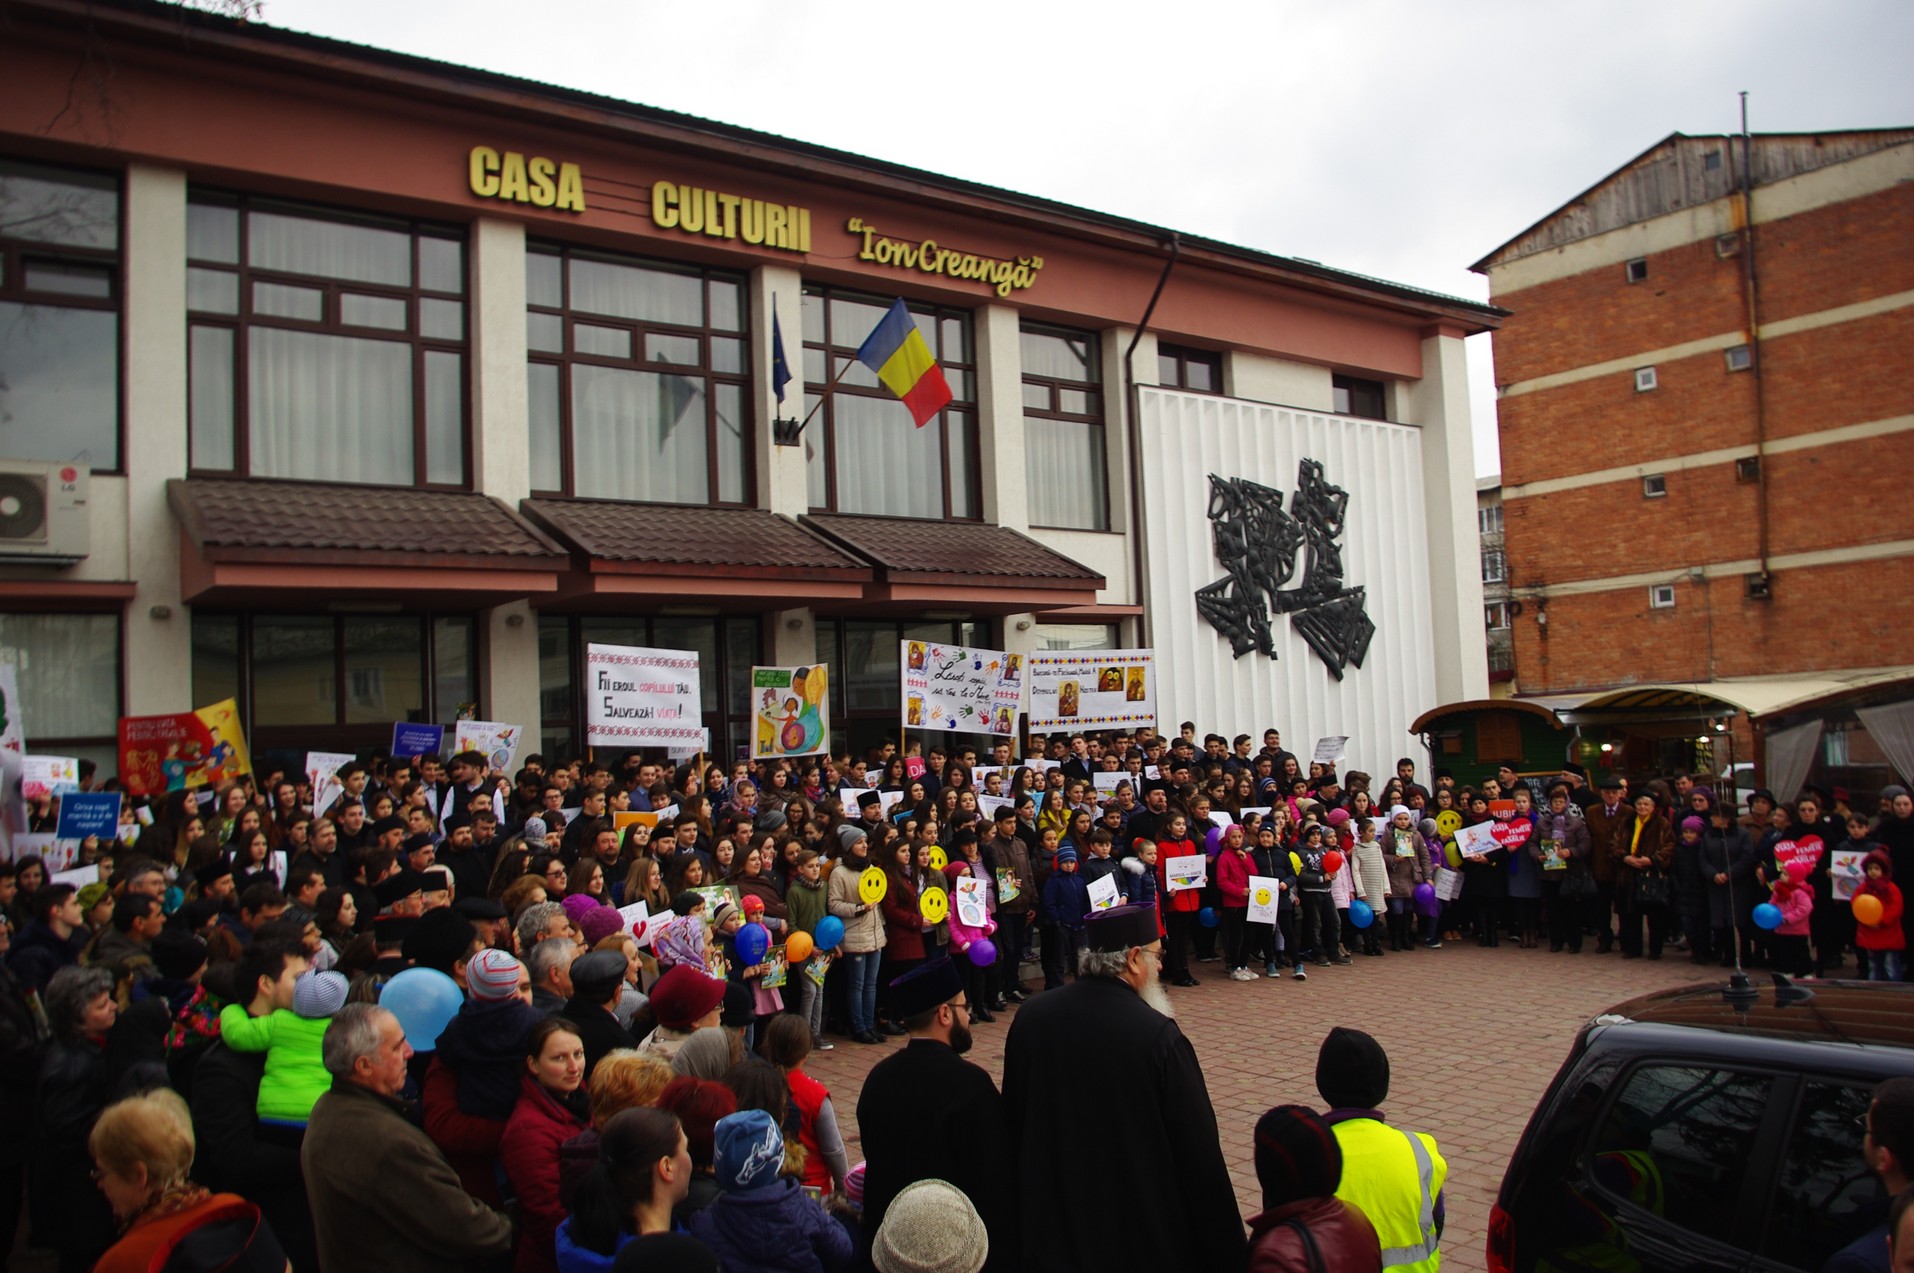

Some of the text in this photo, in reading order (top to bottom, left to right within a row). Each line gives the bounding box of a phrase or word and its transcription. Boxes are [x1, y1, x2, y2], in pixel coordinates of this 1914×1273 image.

[469, 146, 586, 212] CASA
[652, 180, 811, 252] CULTURII
[613, 681, 637, 692] EROUL
